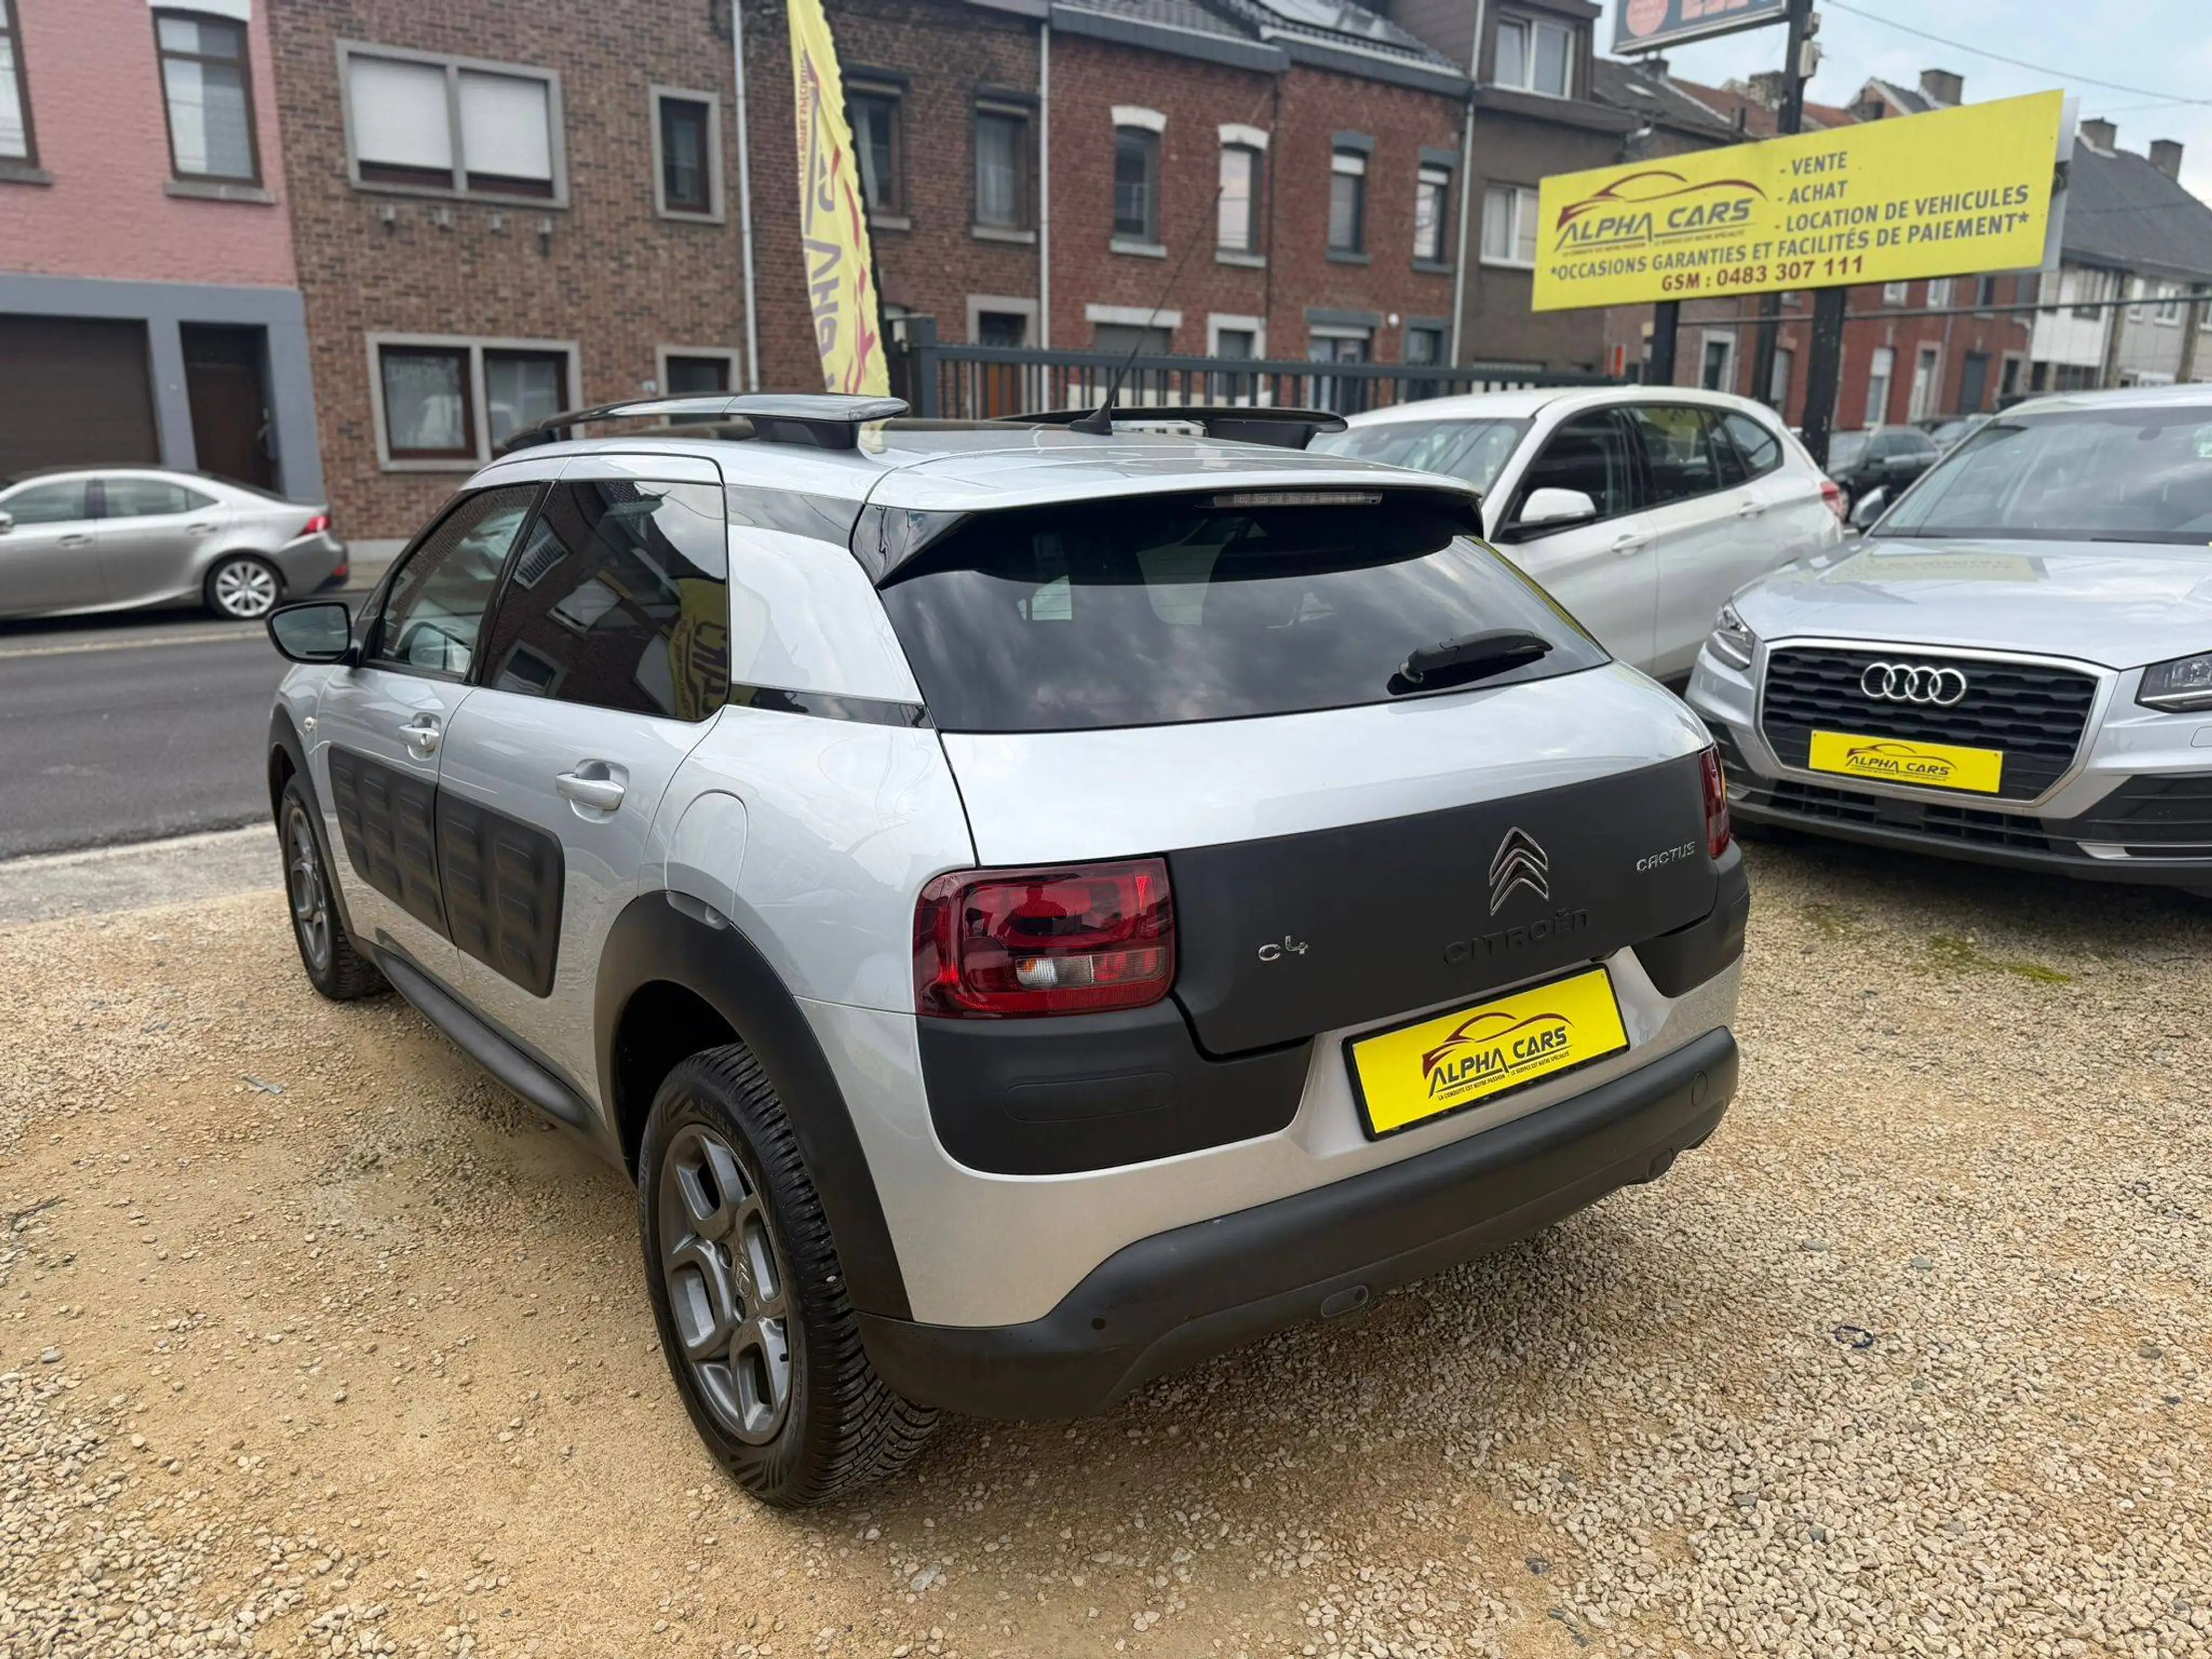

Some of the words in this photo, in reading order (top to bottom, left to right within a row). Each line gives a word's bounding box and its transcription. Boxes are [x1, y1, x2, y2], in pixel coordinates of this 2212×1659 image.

[1791, 151, 1848, 176] VENTE
[1786, 204, 1878, 232] LOCATION
[1885, 200, 1910, 221] DE
[1915, 184, 2029, 216] VEHICULES
[1788, 180, 1848, 205] ACHAT
[1554, 213, 1653, 253] ALPHA
[1667, 198, 1755, 229] CARS
[1652, 244, 1747, 271] GARANTIES
[1752, 241, 1772, 260] ET
[1777, 226, 1869, 259] FACILITÉS
[1876, 228, 1901, 248] DE
[1661, 272, 1700, 292] GSM
[1716, 265, 1767, 287] 0483
[1775, 260, 1816, 282] 307
[1824, 255, 1863, 276] 111
[1845, 756, 1899, 774] ALPHA
[1906, 762, 1951, 775] CARS
[1635, 840, 1696, 873] CACTUS
[1257, 935, 1309, 961] C4
[1443, 908, 1589, 966] CITROËN
[1429, 1047, 1509, 1099] ALPHA
[1512, 1027, 1567, 1058] CARS
